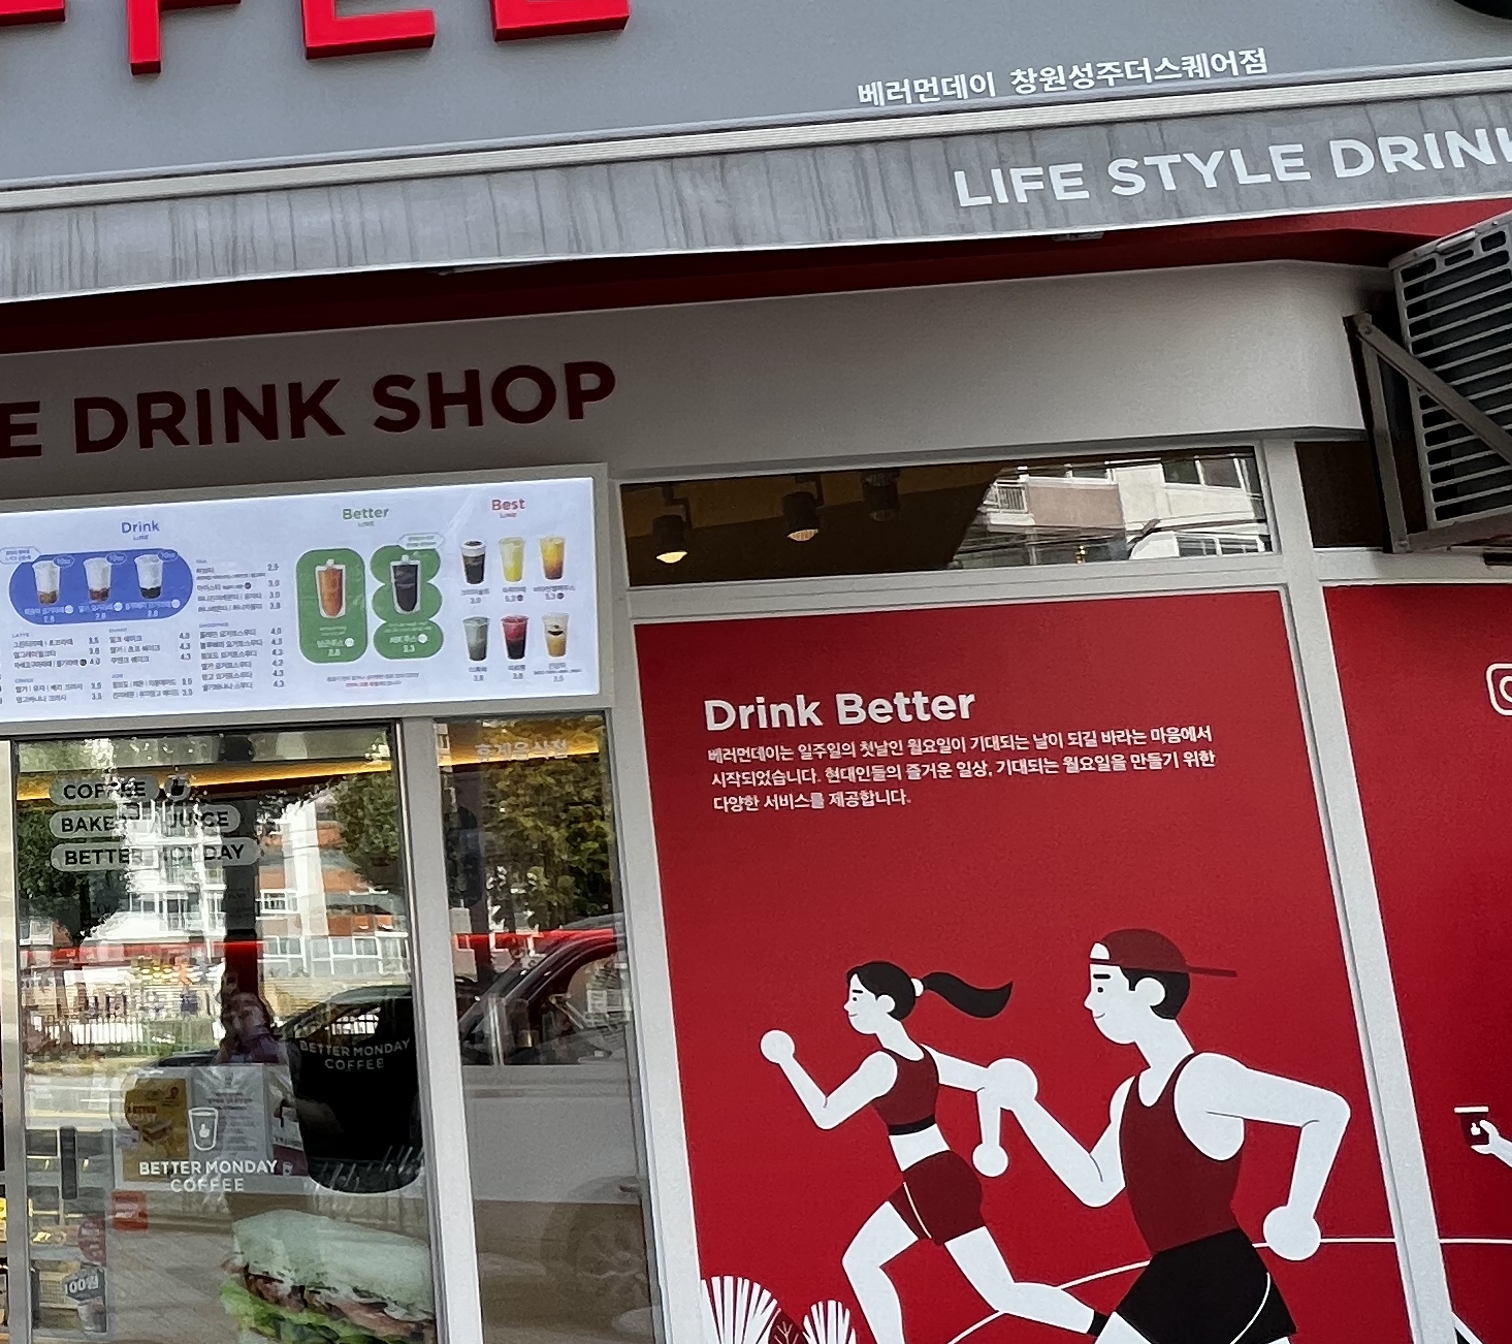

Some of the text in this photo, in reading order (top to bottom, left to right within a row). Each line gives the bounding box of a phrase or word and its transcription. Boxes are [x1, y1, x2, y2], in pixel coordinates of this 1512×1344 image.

[857, 46, 1269, 107] 베러먼데이 창원성주더스퀘어점
[953, 163, 1091, 209] LIFE
[1109, 142, 1313, 198] STYLE
[72, 379, 346, 455] DRINK
[370, 358, 619, 433] SHOP
[342, 507, 390, 521] Better
[491, 498, 526, 511] Best
[121, 520, 161, 535] Drink
[703, 690, 976, 732] Drink Better
[707, 725, 1212, 764] 베러먼데이는 일주일의 첫날인 월요일이 기대되는 날이 되길 바라는 마음에서
[711, 749, 1216, 789] 시작되었습니다. 현대인들의 즐거운 일상, 기대되는 월요일을 만들기 위한
[713, 788, 912, 813] 다양한 서비스를 제공합니다.
[60, 814, 129, 833] BAKE
[299, 1038, 411, 1057] BETTER MONDAY
[324, 1057, 385, 1071] COFFEE
[139, 1159, 278, 1176] BETTER MONDAY
[170, 1178, 245, 1193] COFFEE
